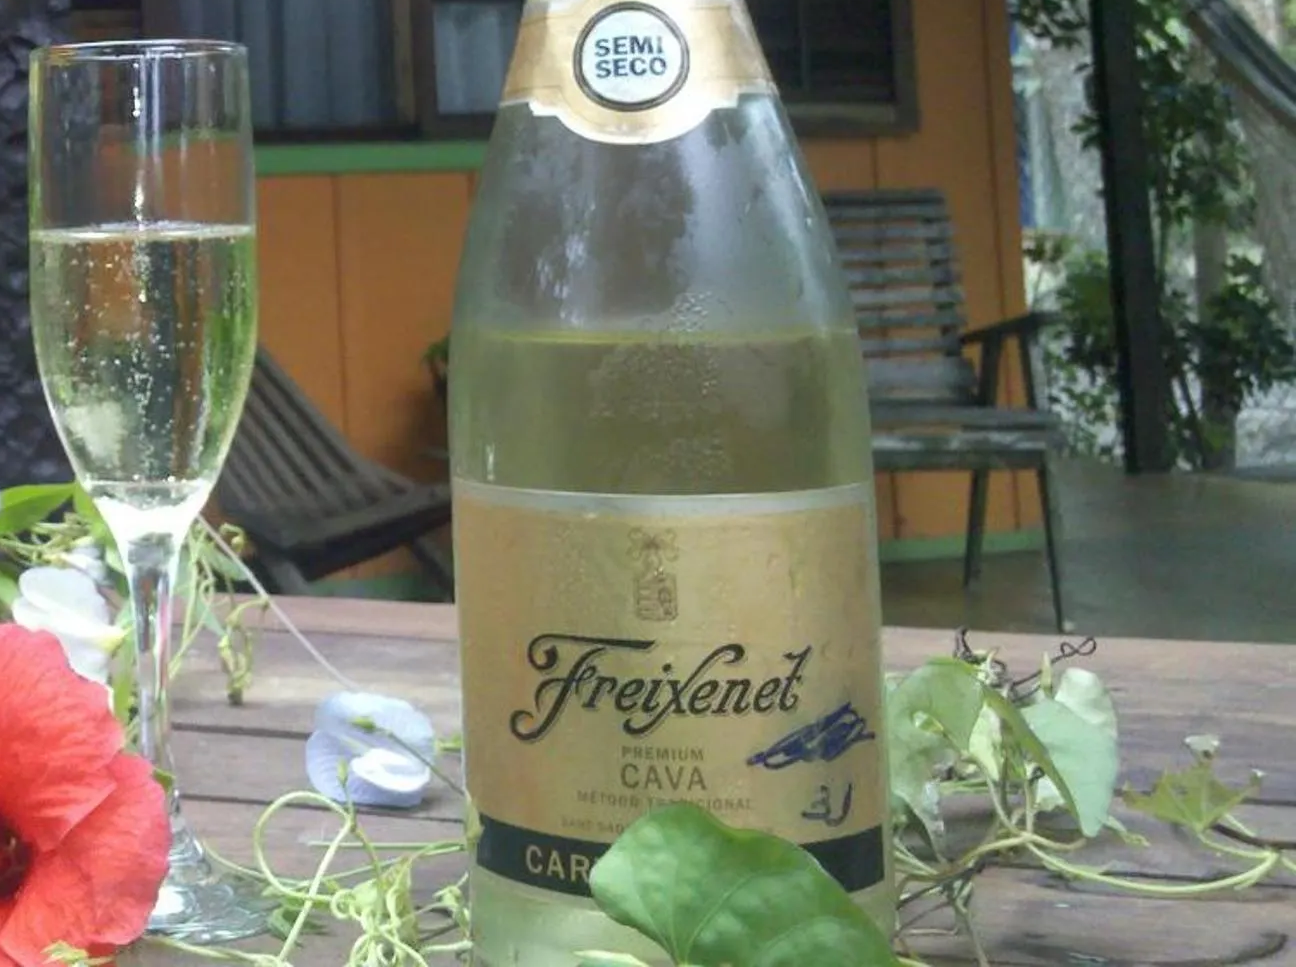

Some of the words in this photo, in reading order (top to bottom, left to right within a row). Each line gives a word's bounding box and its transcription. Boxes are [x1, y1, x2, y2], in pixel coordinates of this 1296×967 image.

[595, 36, 665, 58] SEMI
[595, 57, 667, 79] SECO
[510, 633, 812, 741] Freixenet
[621, 746, 705, 762] PREMIUM
[620, 763, 707, 791] CAVA
[525, 844, 597, 883] CAR
